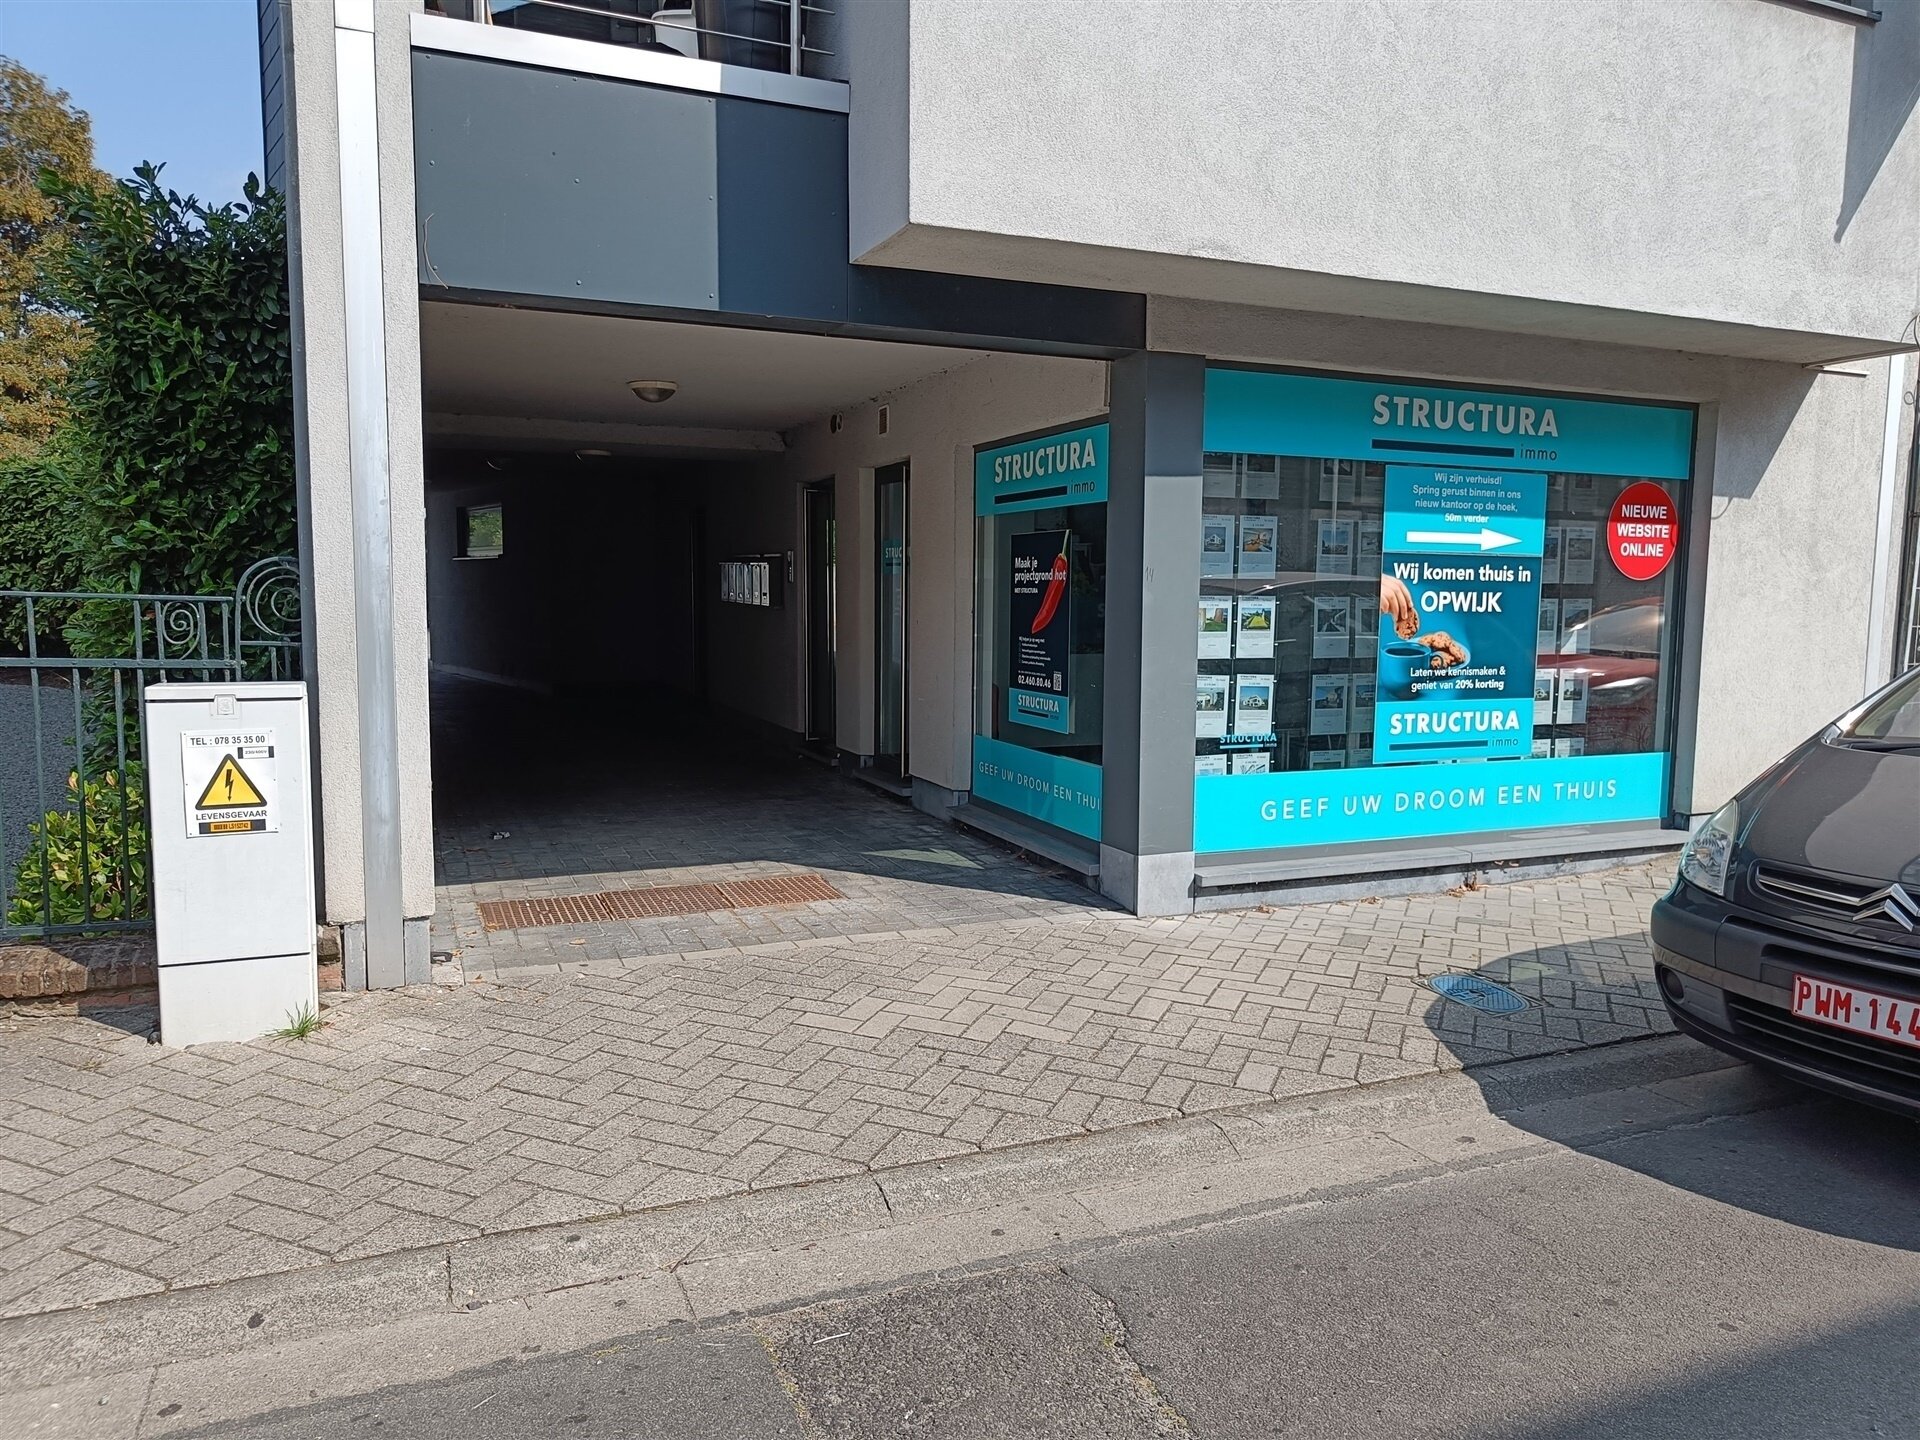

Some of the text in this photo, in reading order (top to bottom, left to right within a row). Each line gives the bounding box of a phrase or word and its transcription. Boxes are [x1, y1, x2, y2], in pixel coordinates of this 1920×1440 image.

[1372, 394, 1558, 438] STRUCTURA
[1520, 444, 1557, 460] immo
[994, 438, 1096, 484] STRUCTURA
[1434, 472, 1502, 485] Wij zijn verhuisd!
[1070, 480, 1095, 493] immo
[1413, 485, 1521, 499] Spring gerust binnen in ons
[1415, 499, 1518, 512] nieuw kantoor op de hoek,
[1622, 504, 1667, 519] NIEUWE
[1445, 513, 1489, 523] 50m verder
[1616, 523, 1669, 538] WEBSITE
[1620, 543, 1664, 557] ONLINE
[1014, 556, 1038, 572] Maak je
[1014, 568, 1066, 586] projectgrond hot
[1394, 562, 1531, 584] Wij komen thuis in
[1420, 591, 1503, 613] OPWIJK
[1410, 666, 1506, 677] Laten we kennismaken &
[1017, 675, 1052, 689] 02.460.80.46
[1411, 679, 1504, 693] geniet van 20% korting
[1017, 694, 1060, 713] STRUCTURA
[1390, 710, 1520, 735] STRUCTURA
[190, 737, 207, 746] TEL
[214, 736, 230, 744] 078
[232, 736, 242, 744] 35
[256, 735, 265, 743] 00
[1220, 733, 1277, 743] STRUCTURA
[1491, 736, 1518, 747] immo
[978, 761, 998, 776] GEEF
[1001, 770, 1014, 782] UW
[1017, 773, 1050, 794] DROOM
[1054, 784, 1072, 802] EEN
[1261, 779, 1617, 821] GEEF UW DROOM EEN THUIS
[196, 810, 267, 821] LEVENSGEVAAR
[1798, 980, 1920, 1041] PWM-144
